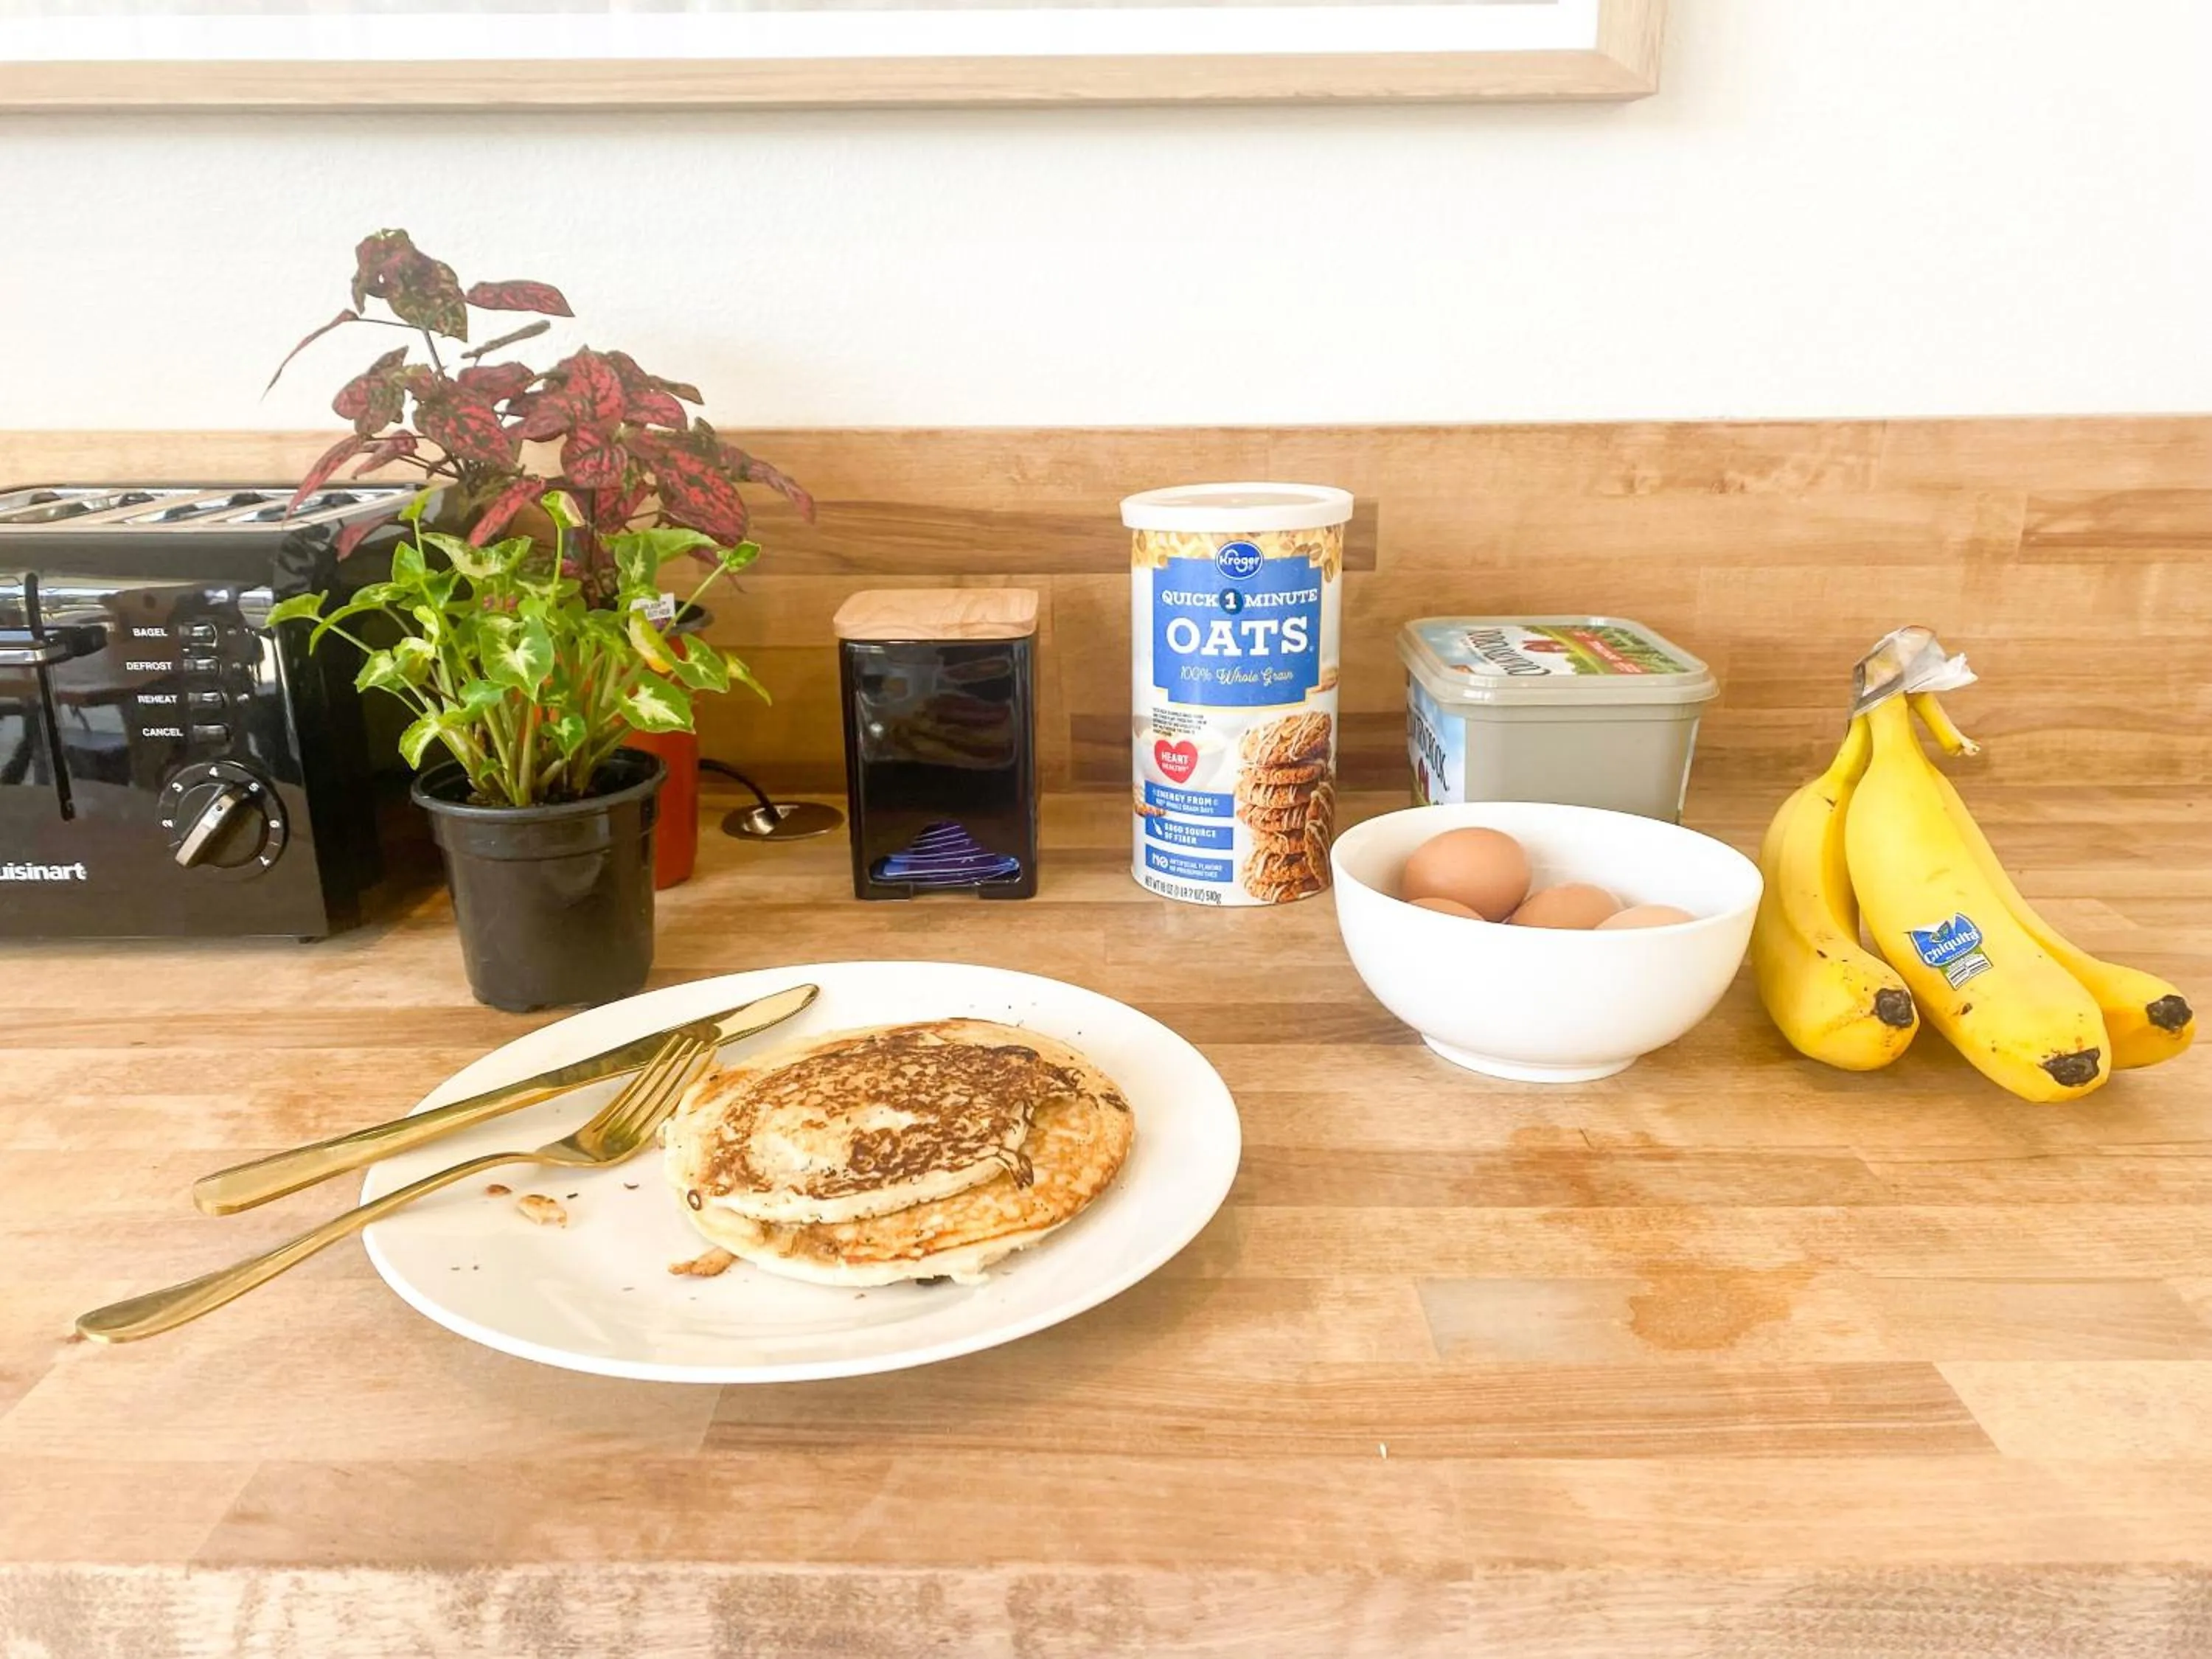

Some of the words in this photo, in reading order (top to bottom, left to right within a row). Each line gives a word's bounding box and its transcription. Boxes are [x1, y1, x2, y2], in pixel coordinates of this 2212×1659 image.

[1219, 549, 1260, 573] Kroger
[1161, 590, 1217, 607] QUICK
[1224, 592, 1237, 609] 1
[1244, 589, 1318, 608] MINUTE
[133, 627, 168, 636] BAGEL
[1166, 616, 1308, 656] OATS
[126, 661, 172, 670] DEFROST
[1180, 665, 1212, 682] 100%
[1216, 666, 1259, 685] Whole
[137, 694, 178, 703] REHEAT
[142, 727, 184, 737] CANCEL
[1161, 751, 1189, 765] HEART
[209, 766, 218, 776] 4
[248, 782, 260, 792] 5
[1157, 790, 1185, 803] ENERGY
[1186, 796, 1211, 806] FROM
[161, 819, 173, 828] 2
[1185, 826, 1216, 838] SOURCE
[260, 855, 270, 866] 7
[1152, 852, 1169, 868] NO
[1924, 928, 1980, 964] Chiquita
